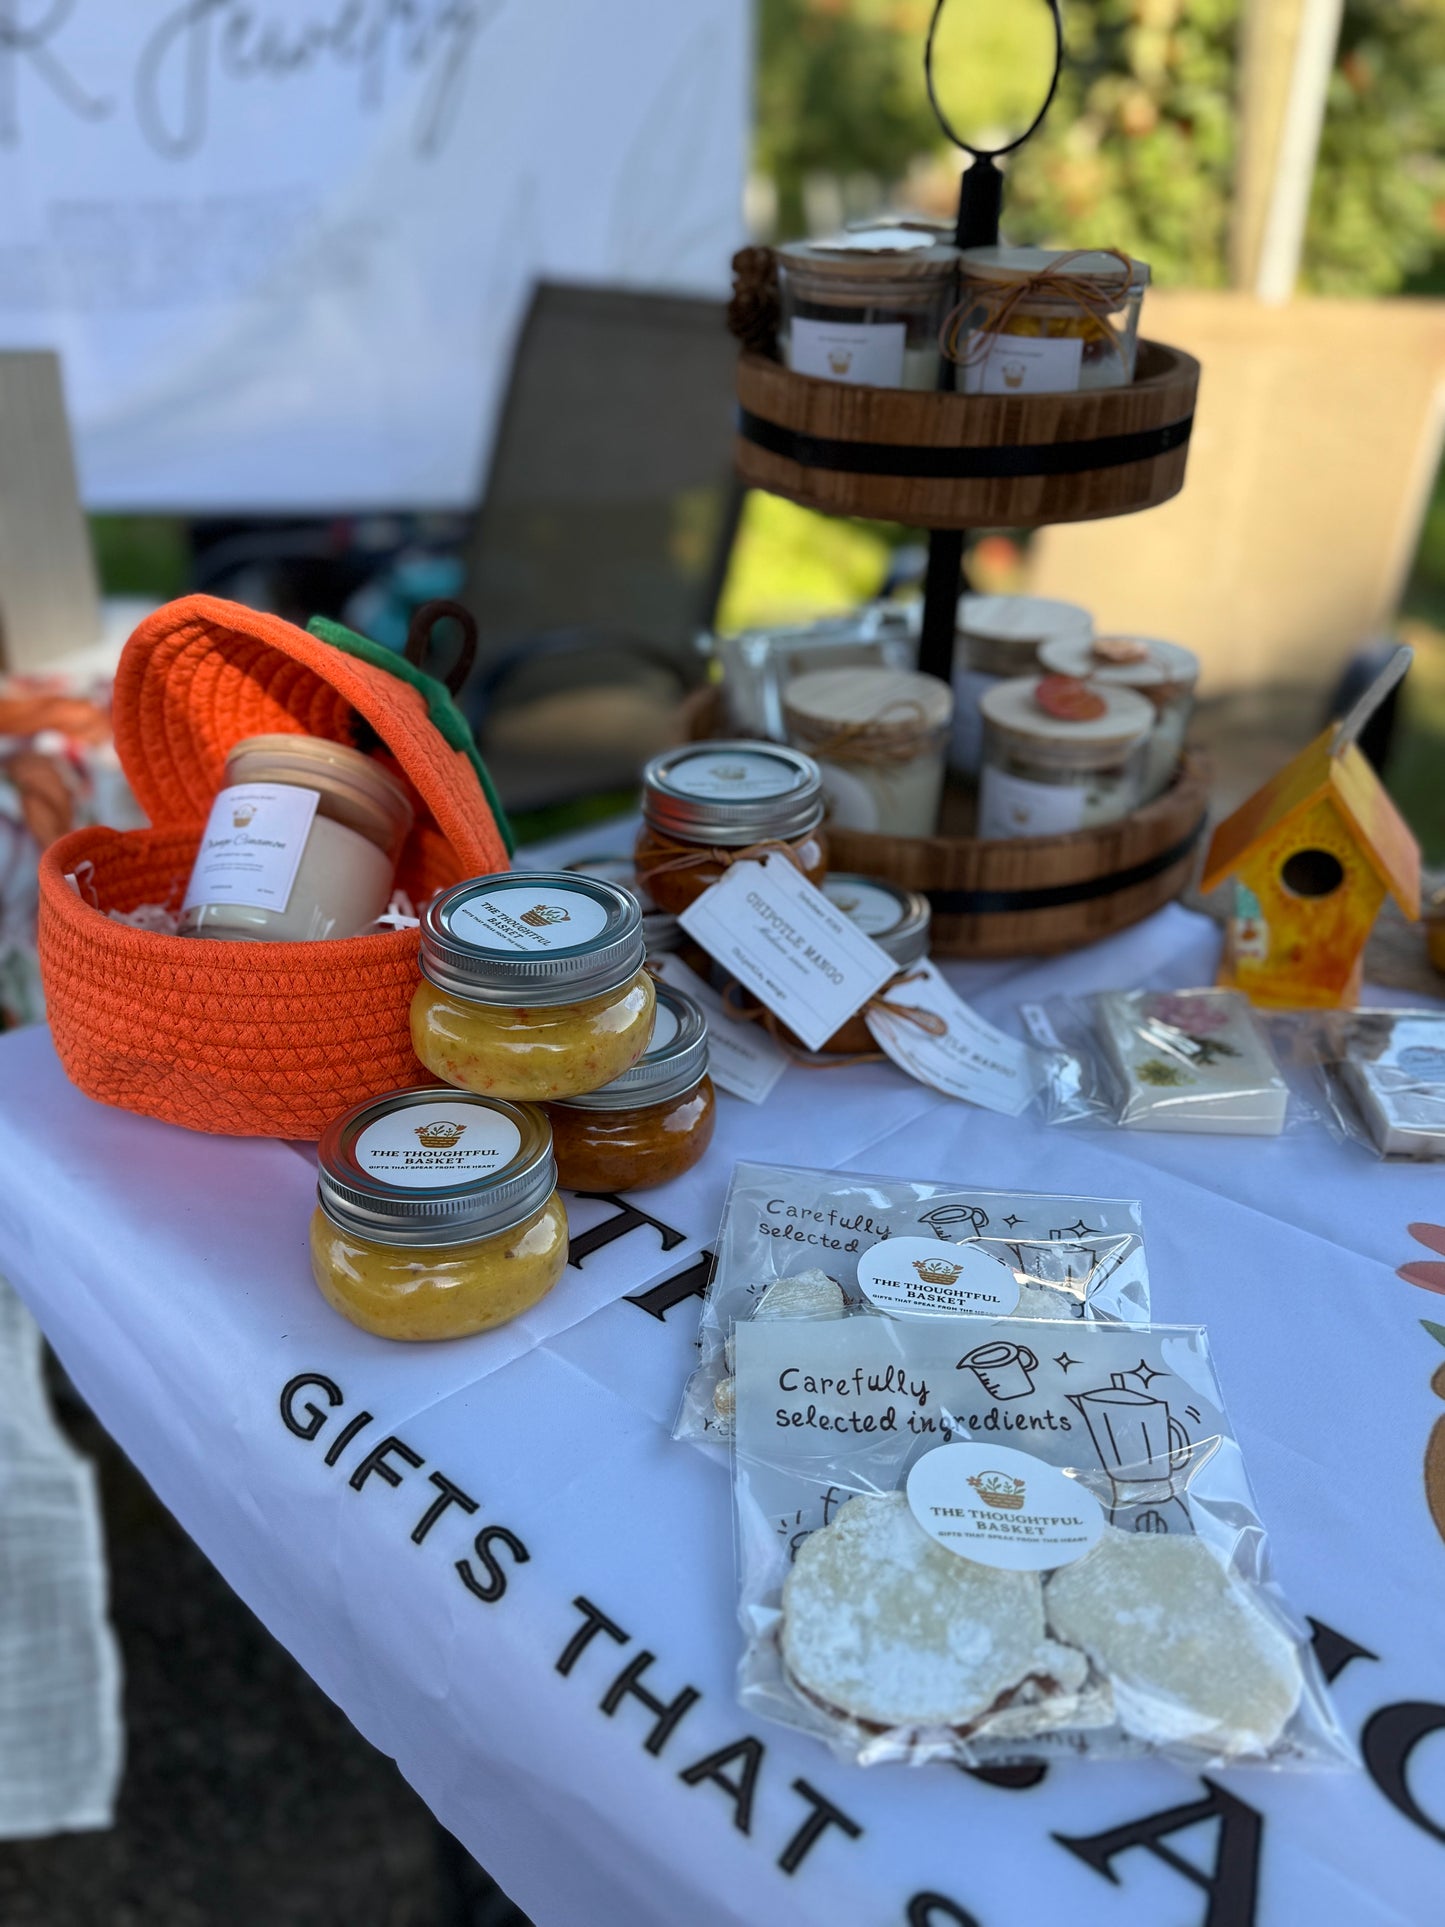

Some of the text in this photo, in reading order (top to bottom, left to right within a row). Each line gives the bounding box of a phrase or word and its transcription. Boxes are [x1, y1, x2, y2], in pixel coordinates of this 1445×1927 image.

[481, 902, 552, 947] THE THOUGHTFUL
[487, 917, 524, 939] BASKET
[746, 892, 845, 986] CHIPOTLE MANGO
[403, 1149, 500, 1157] THOUGHTFUL
[766, 1199, 892, 1240] Carefully
[759, 1222, 858, 1253] selected
[872, 1277, 1001, 1303] THE THOUGHTFUL
[872, 1293, 893, 1301] GIFTS
[907, 1290, 967, 1306] BASKET
[778, 1365, 931, 1406] Carefully
[775, 1404, 897, 1434] selected
[906, 1407, 1073, 1443] ingredients
[930, 1507, 1084, 1526] THE THOUGHTFUL
[975, 1521, 1046, 1536] BASKET
[279, 1373, 531, 1604] GIFTS
[554, 1596, 863, 1876] THAT
